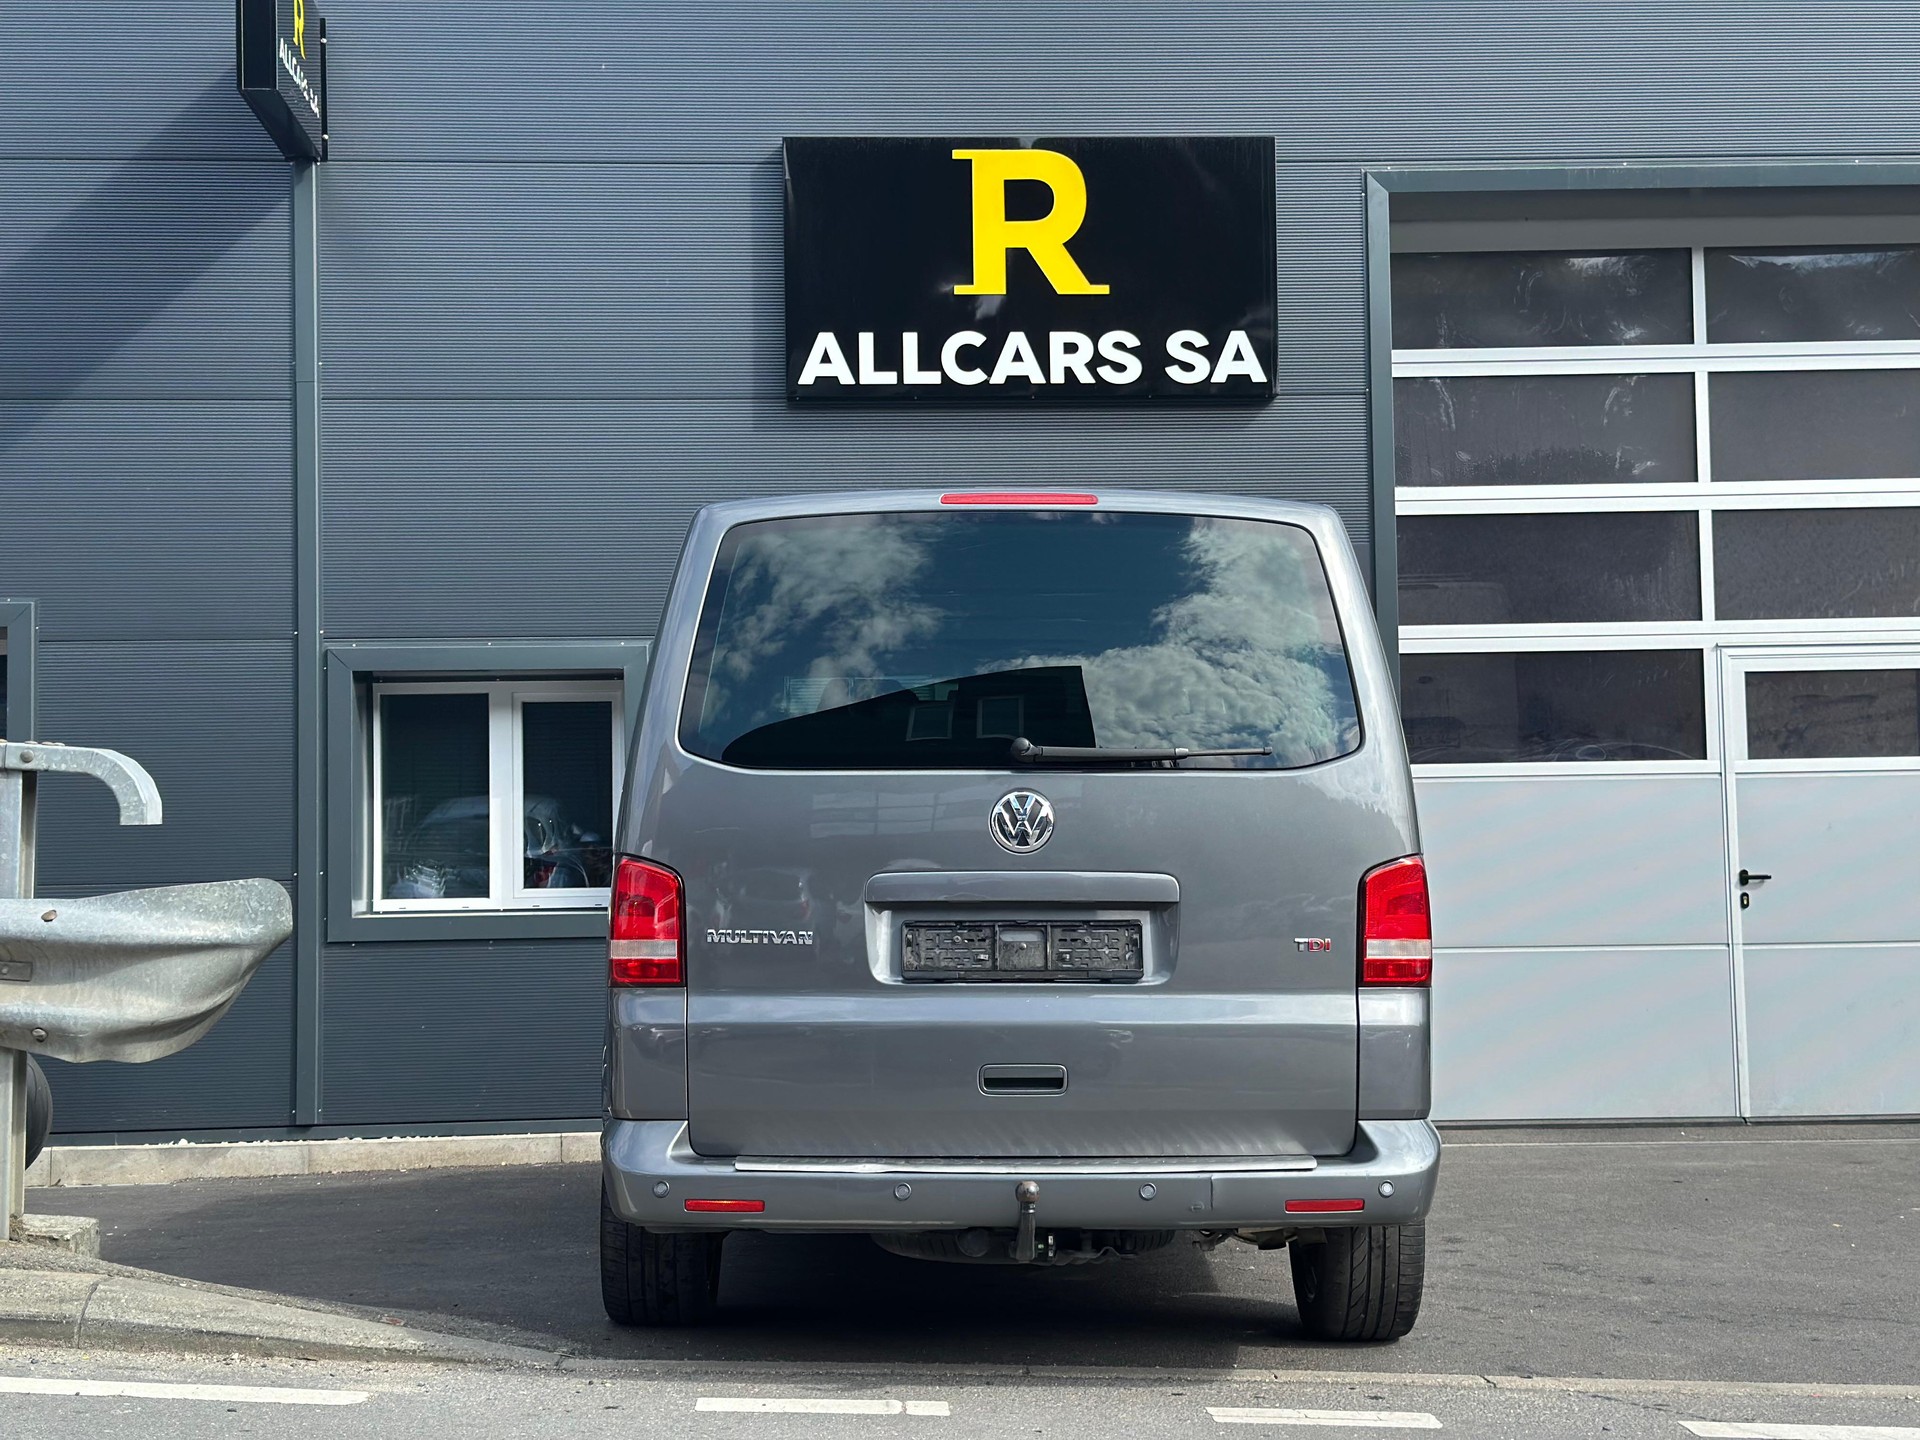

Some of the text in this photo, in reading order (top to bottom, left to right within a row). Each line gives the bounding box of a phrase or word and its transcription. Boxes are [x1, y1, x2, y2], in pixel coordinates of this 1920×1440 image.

[952, 149, 1110, 294] R
[798, 330, 1268, 385] ALLCARS SA
[706, 929, 814, 945] MULTIVAN
[1294, 937, 1331, 952] TDI
